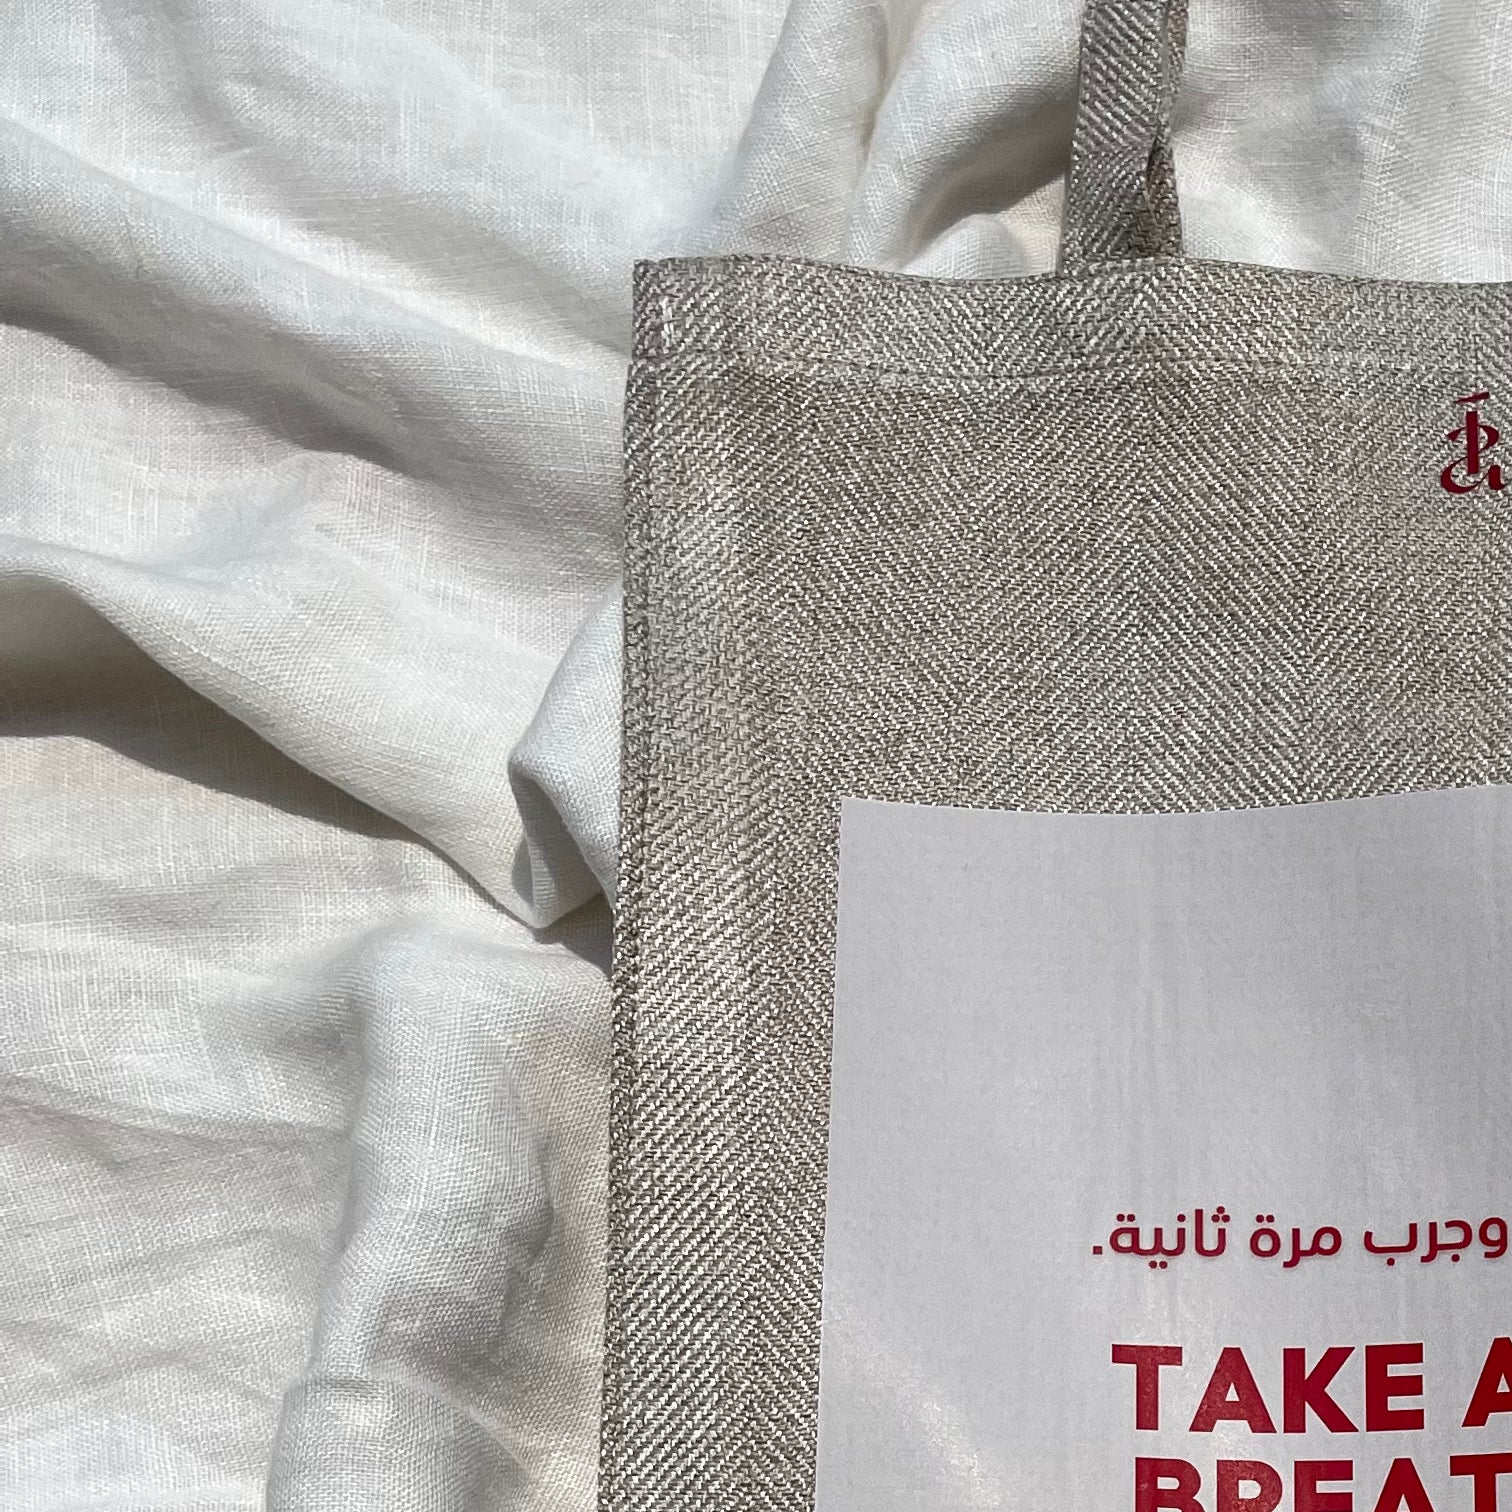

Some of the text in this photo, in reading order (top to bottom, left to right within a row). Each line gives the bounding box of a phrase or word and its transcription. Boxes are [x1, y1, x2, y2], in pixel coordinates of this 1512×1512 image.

[1093, 1207, 1230, 1270] ثانية.
[1249, 1214, 1342, 1269] مرة
[1363, 1217, 1508, 1266] وجرب
[1111, 1342, 1425, 1434] TAKE
